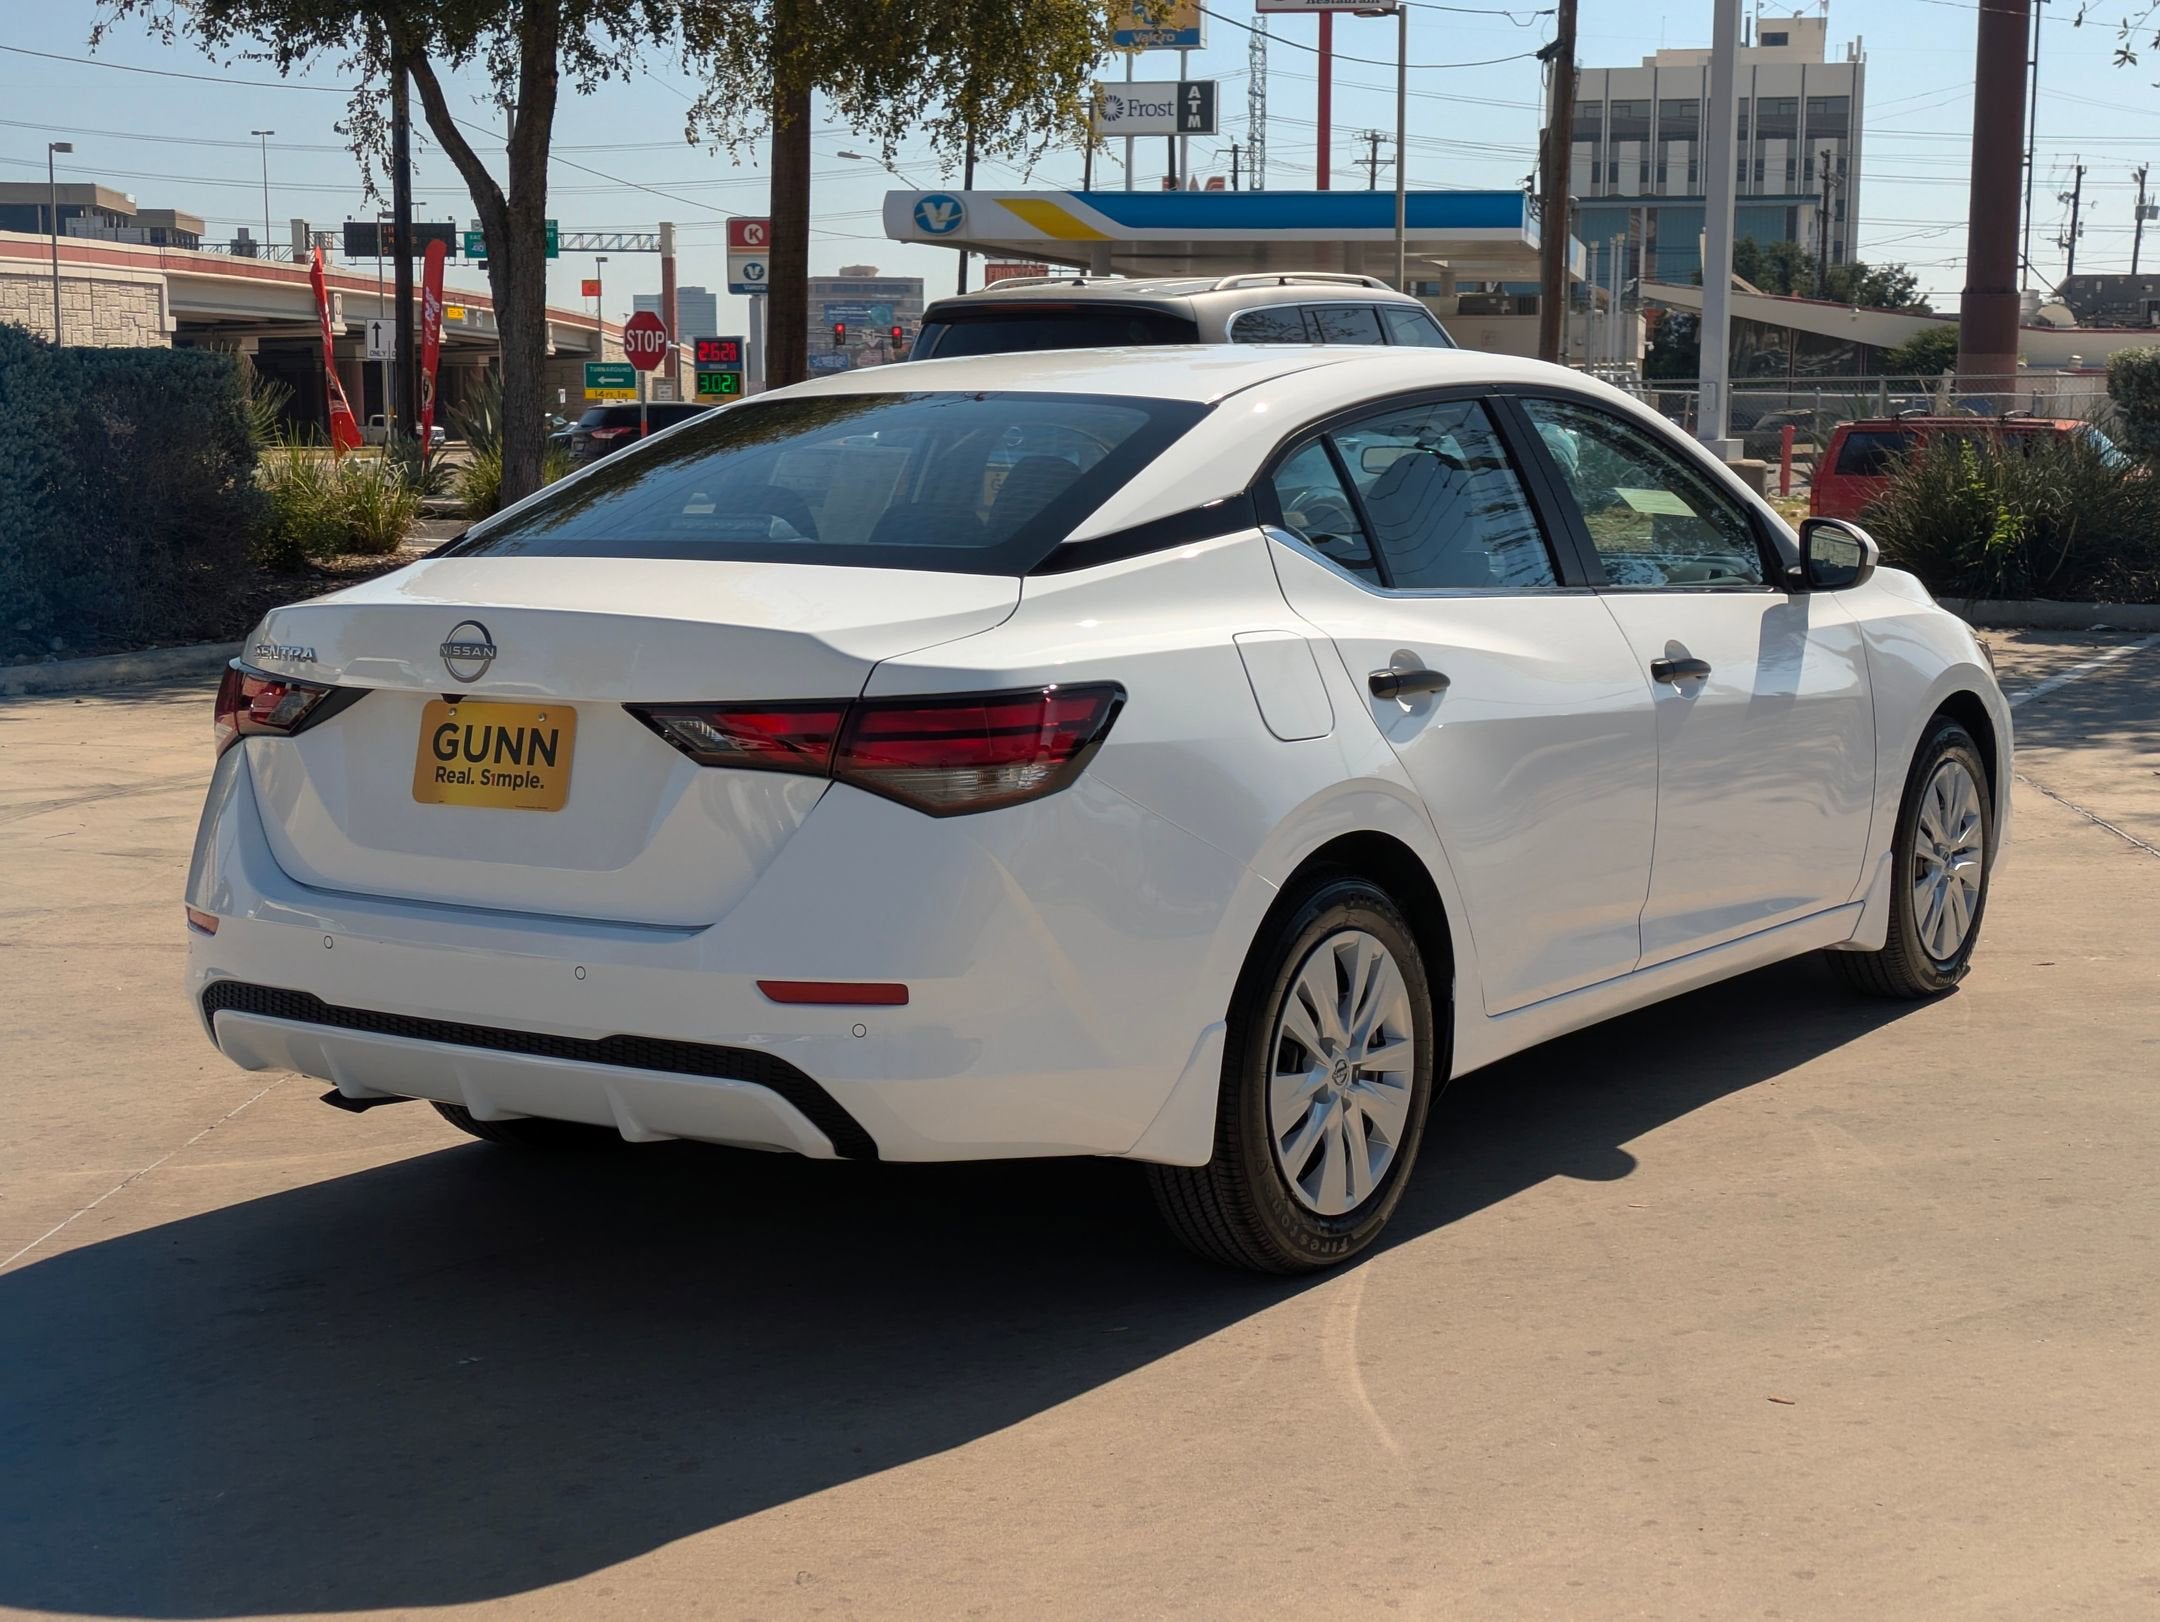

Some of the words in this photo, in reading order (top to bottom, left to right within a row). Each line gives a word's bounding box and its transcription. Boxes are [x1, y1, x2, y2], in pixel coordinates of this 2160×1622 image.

[1127, 99, 1175, 117] Frost
[1187, 85, 1202, 129] ATM
[625, 329, 665, 353] STOP
[700, 374, 731, 393] 3.02
[254, 643, 318, 663] SENTRA
[440, 643, 495, 658] NISSAN
[432, 722, 559, 767] GUNN
[435, 765, 475, 785] Real.
